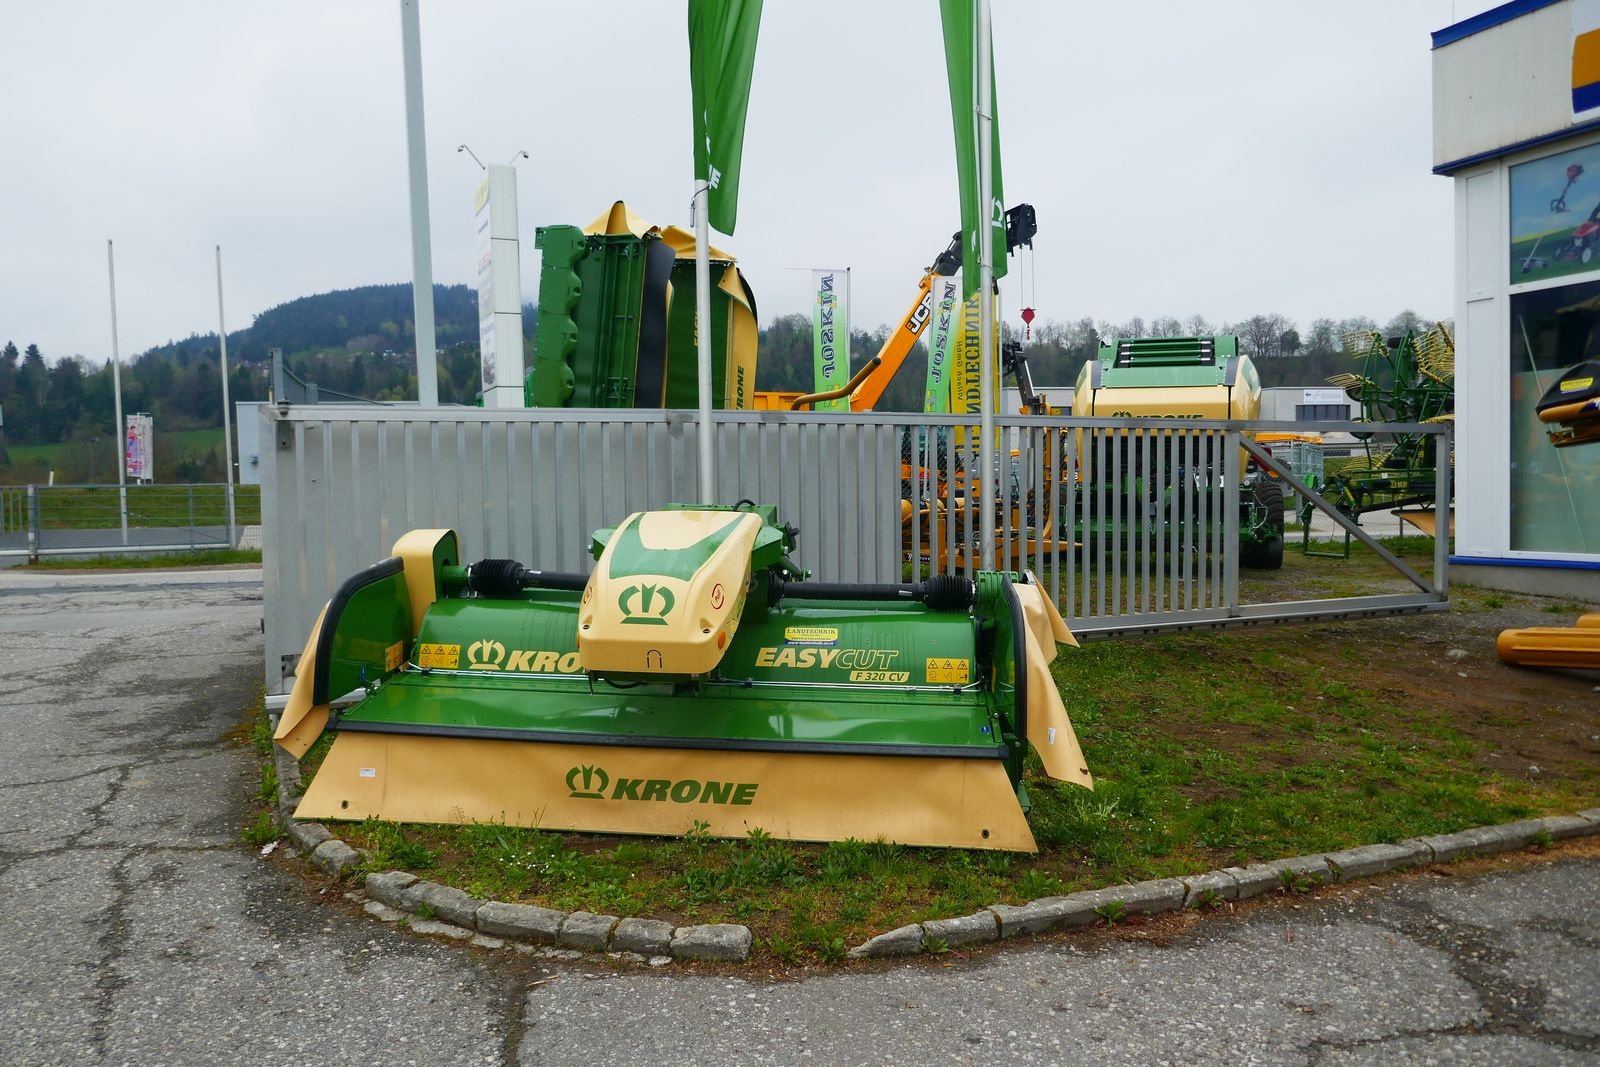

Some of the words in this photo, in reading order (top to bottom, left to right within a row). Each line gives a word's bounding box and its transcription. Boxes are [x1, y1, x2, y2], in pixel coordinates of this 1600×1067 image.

[932, 281, 956, 384] JOSKIN
[736, 365, 744, 410] RONE
[505, 650, 586, 673] KRO
[755, 647, 899, 669] EASYCUT
[855, 672, 862, 680] F
[865, 672, 885, 681] 320
[888, 673, 904, 681] CV
[611, 778, 759, 805] KRONE
